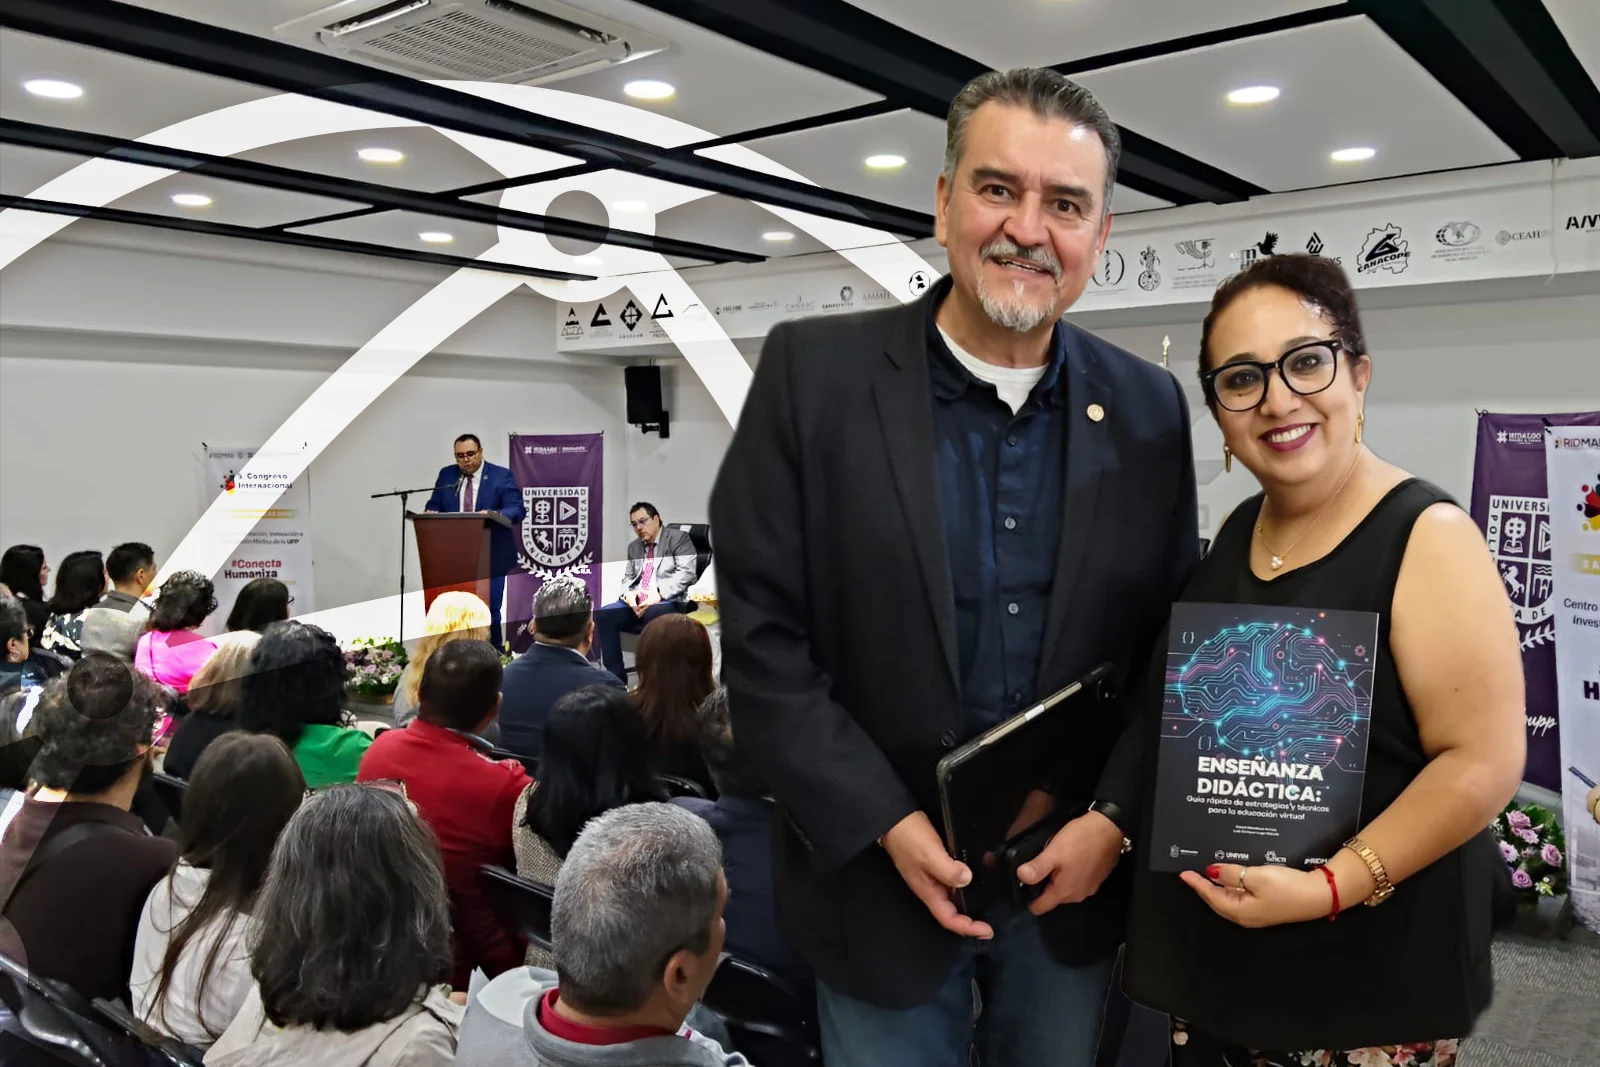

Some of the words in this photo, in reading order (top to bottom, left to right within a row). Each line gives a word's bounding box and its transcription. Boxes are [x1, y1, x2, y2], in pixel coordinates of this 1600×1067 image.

[1357, 251, 1411, 273] CANACOPE
[524, 488, 587, 497] UNIVERSIDAD
[231, 558, 282, 569] #Conecta
[224, 568, 278, 579] Humaniza
[1563, 597, 1598, 612] Centro
[1197, 755, 1324, 781] ENSEÑANZA
[1196, 776, 1322, 803] DIDÁCTICA:
[1233, 798, 1244, 806] de
[1244, 800, 1289, 810] estrategias
[1208, 807, 1227, 815] para
[1227, 807, 1236, 815] la
[1237, 808, 1278, 818] educación
[1279, 811, 1306, 820] virtual
